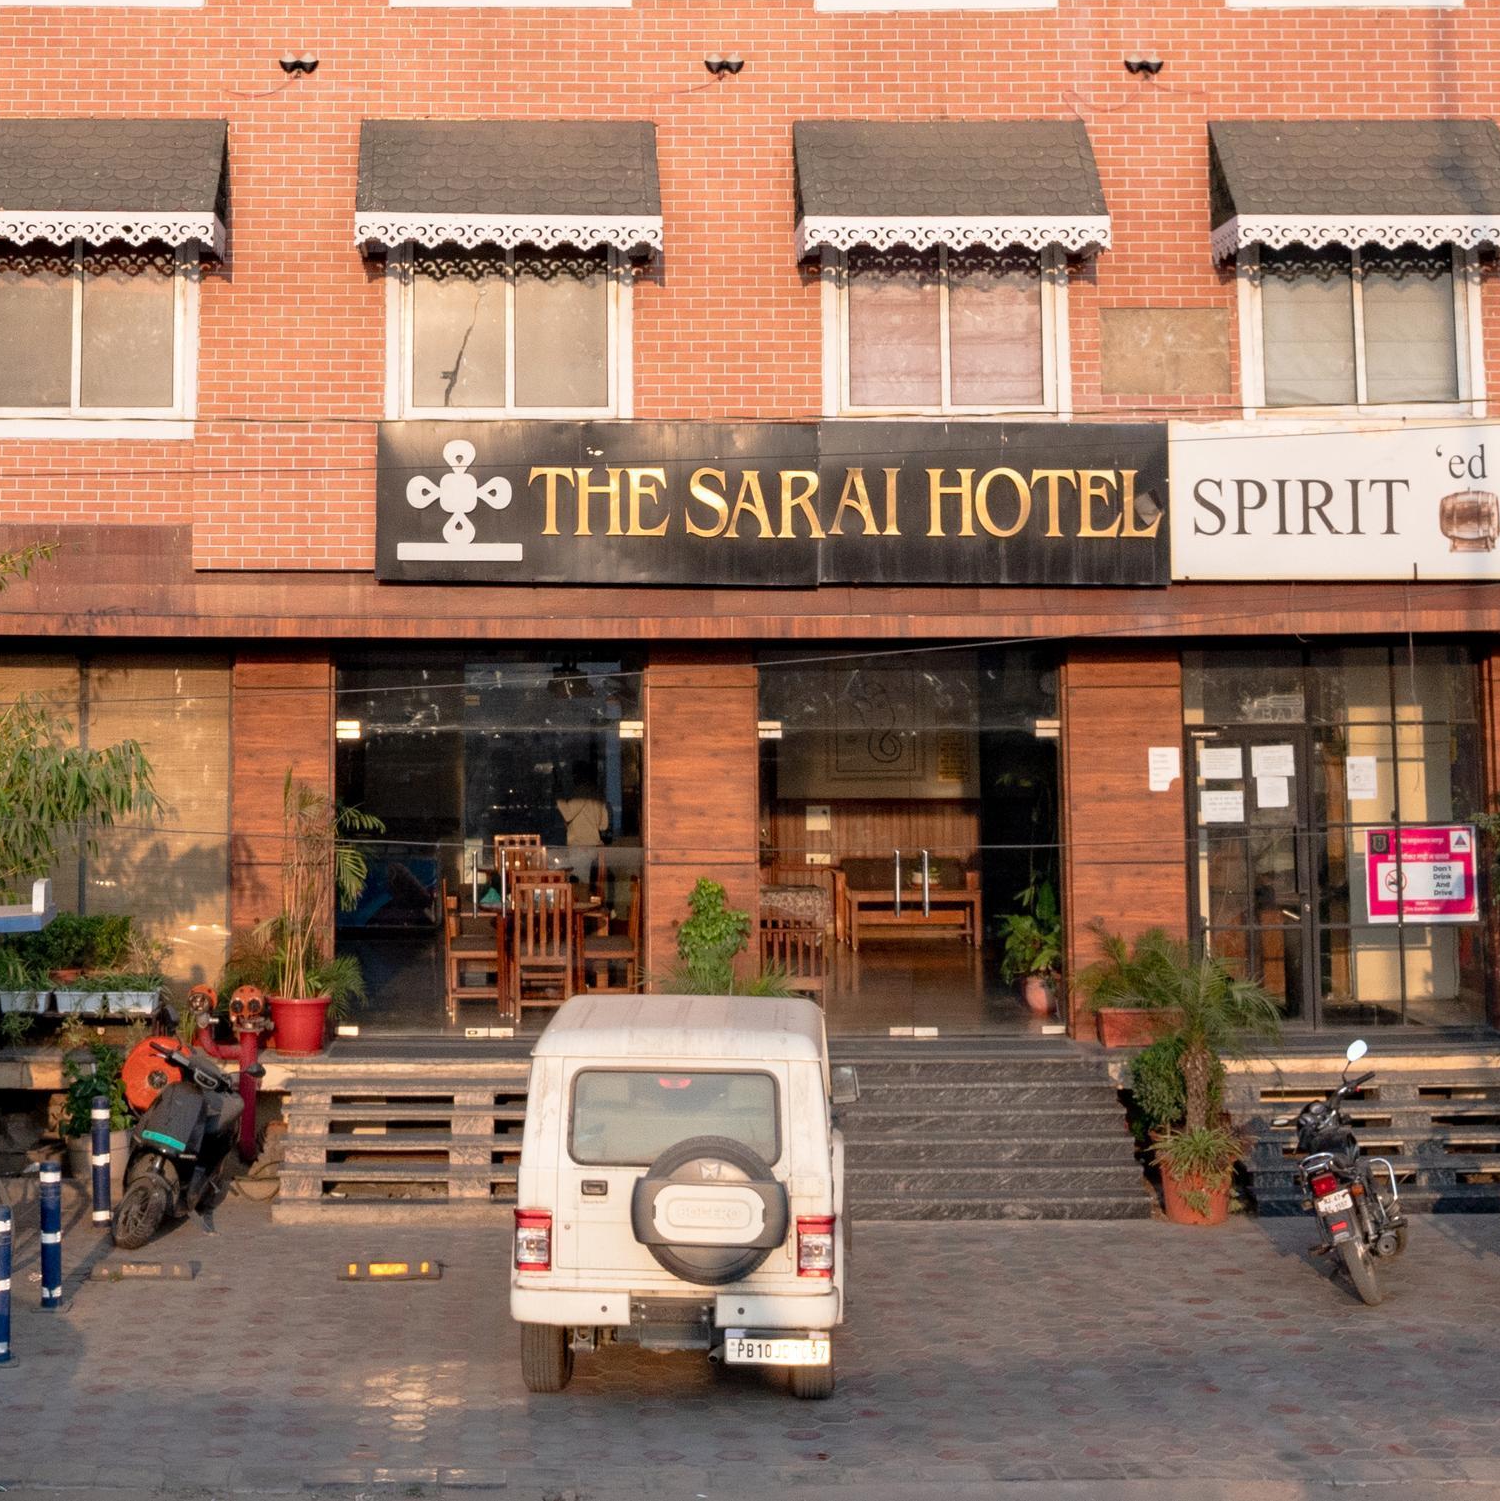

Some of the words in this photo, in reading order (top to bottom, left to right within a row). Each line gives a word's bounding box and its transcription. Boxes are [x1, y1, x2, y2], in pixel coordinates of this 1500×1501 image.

[527, 466, 670, 538] THE
[685, 466, 902, 540] SARAI
[925, 466, 1164, 539] HOTEL
[1192, 477, 1411, 537] SPIRIT
